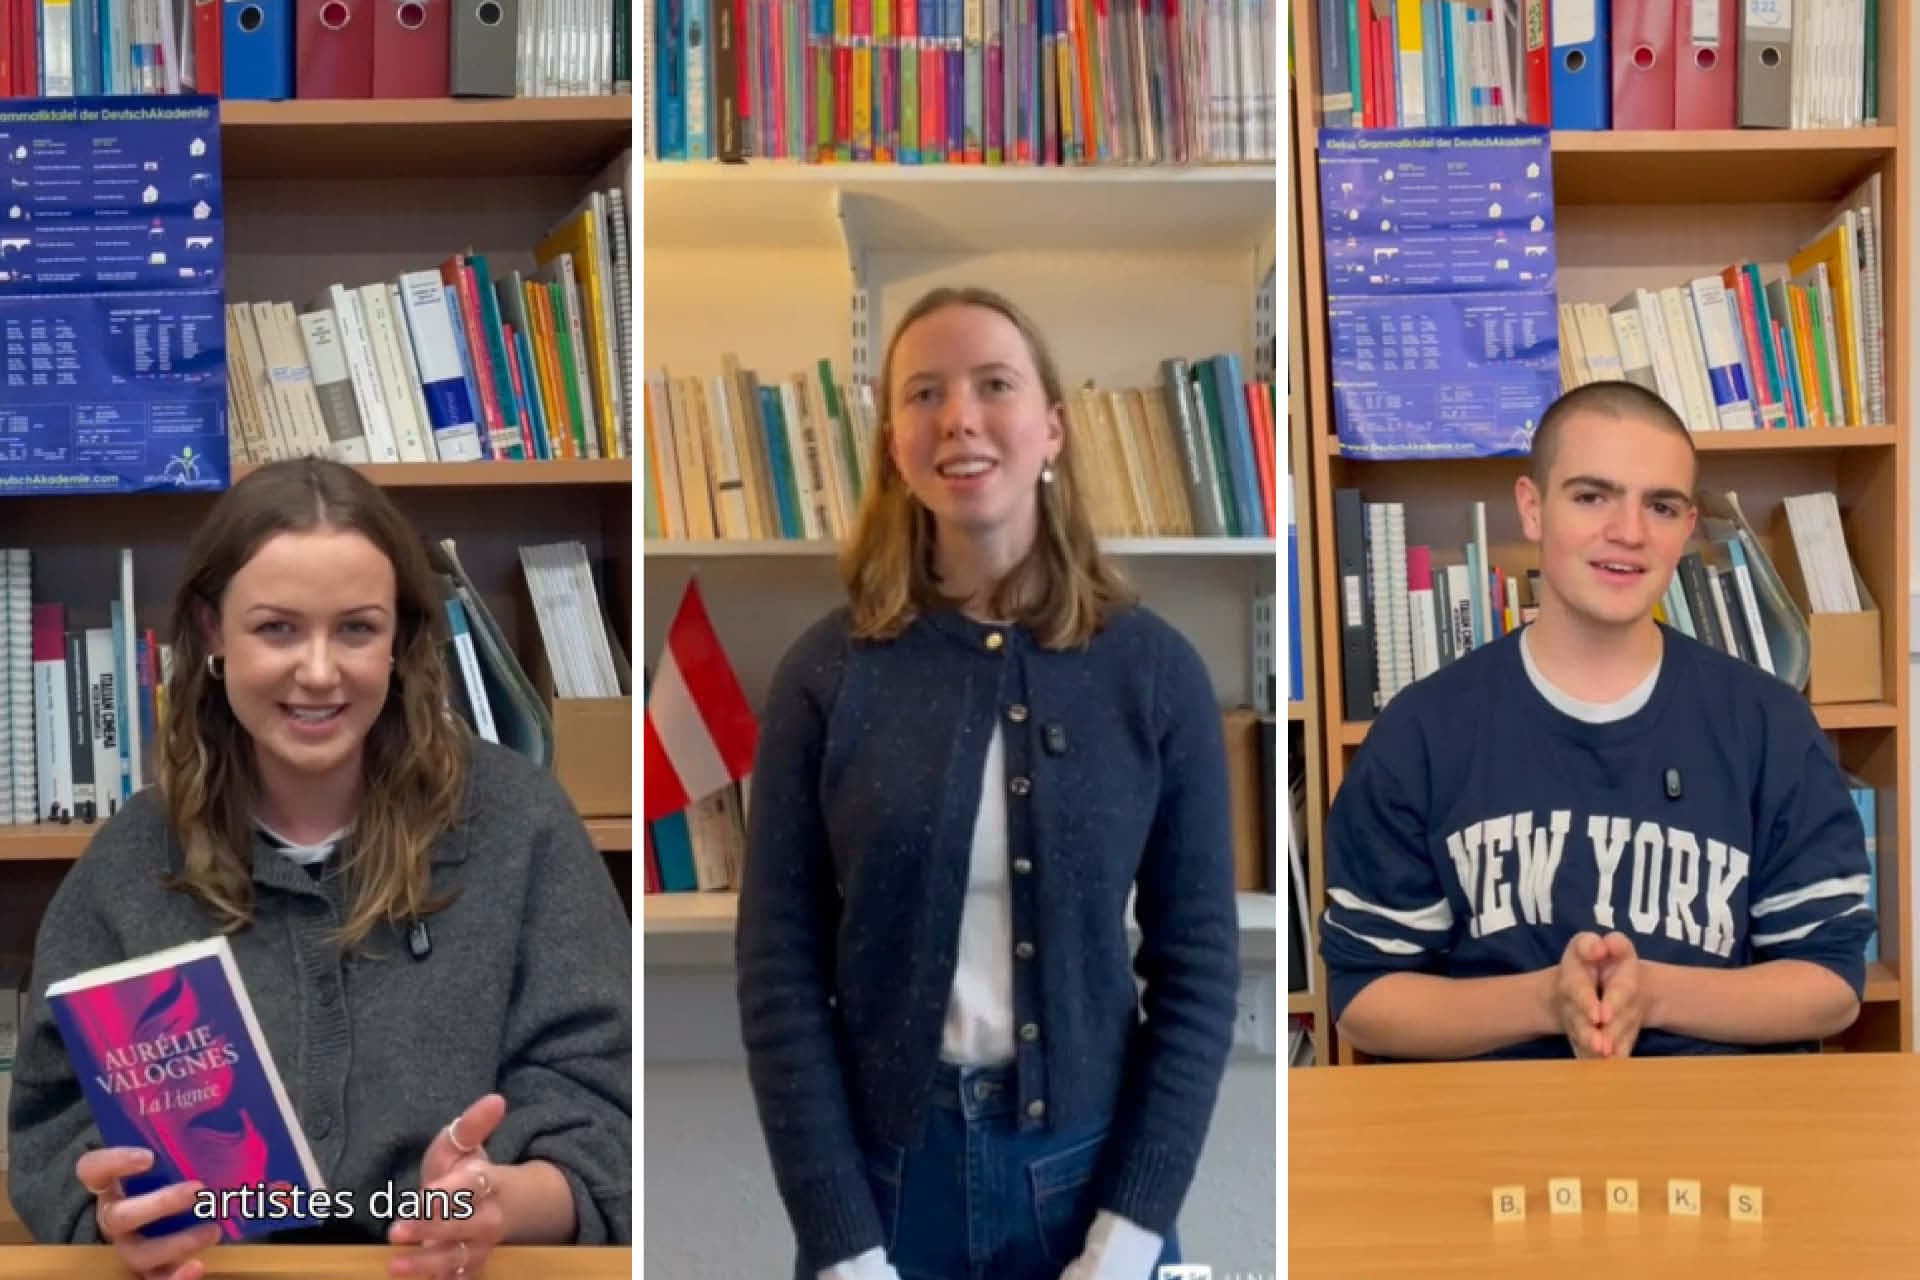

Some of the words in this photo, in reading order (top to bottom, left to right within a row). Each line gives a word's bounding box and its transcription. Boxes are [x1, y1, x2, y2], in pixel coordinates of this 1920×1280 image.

[1446, 810, 1571, 938] NEW
[1588, 815, 1749, 957] YORK
[95, 1043, 240, 1095] VALOGNES
[105, 1025, 216, 1071] AURÉLIE
